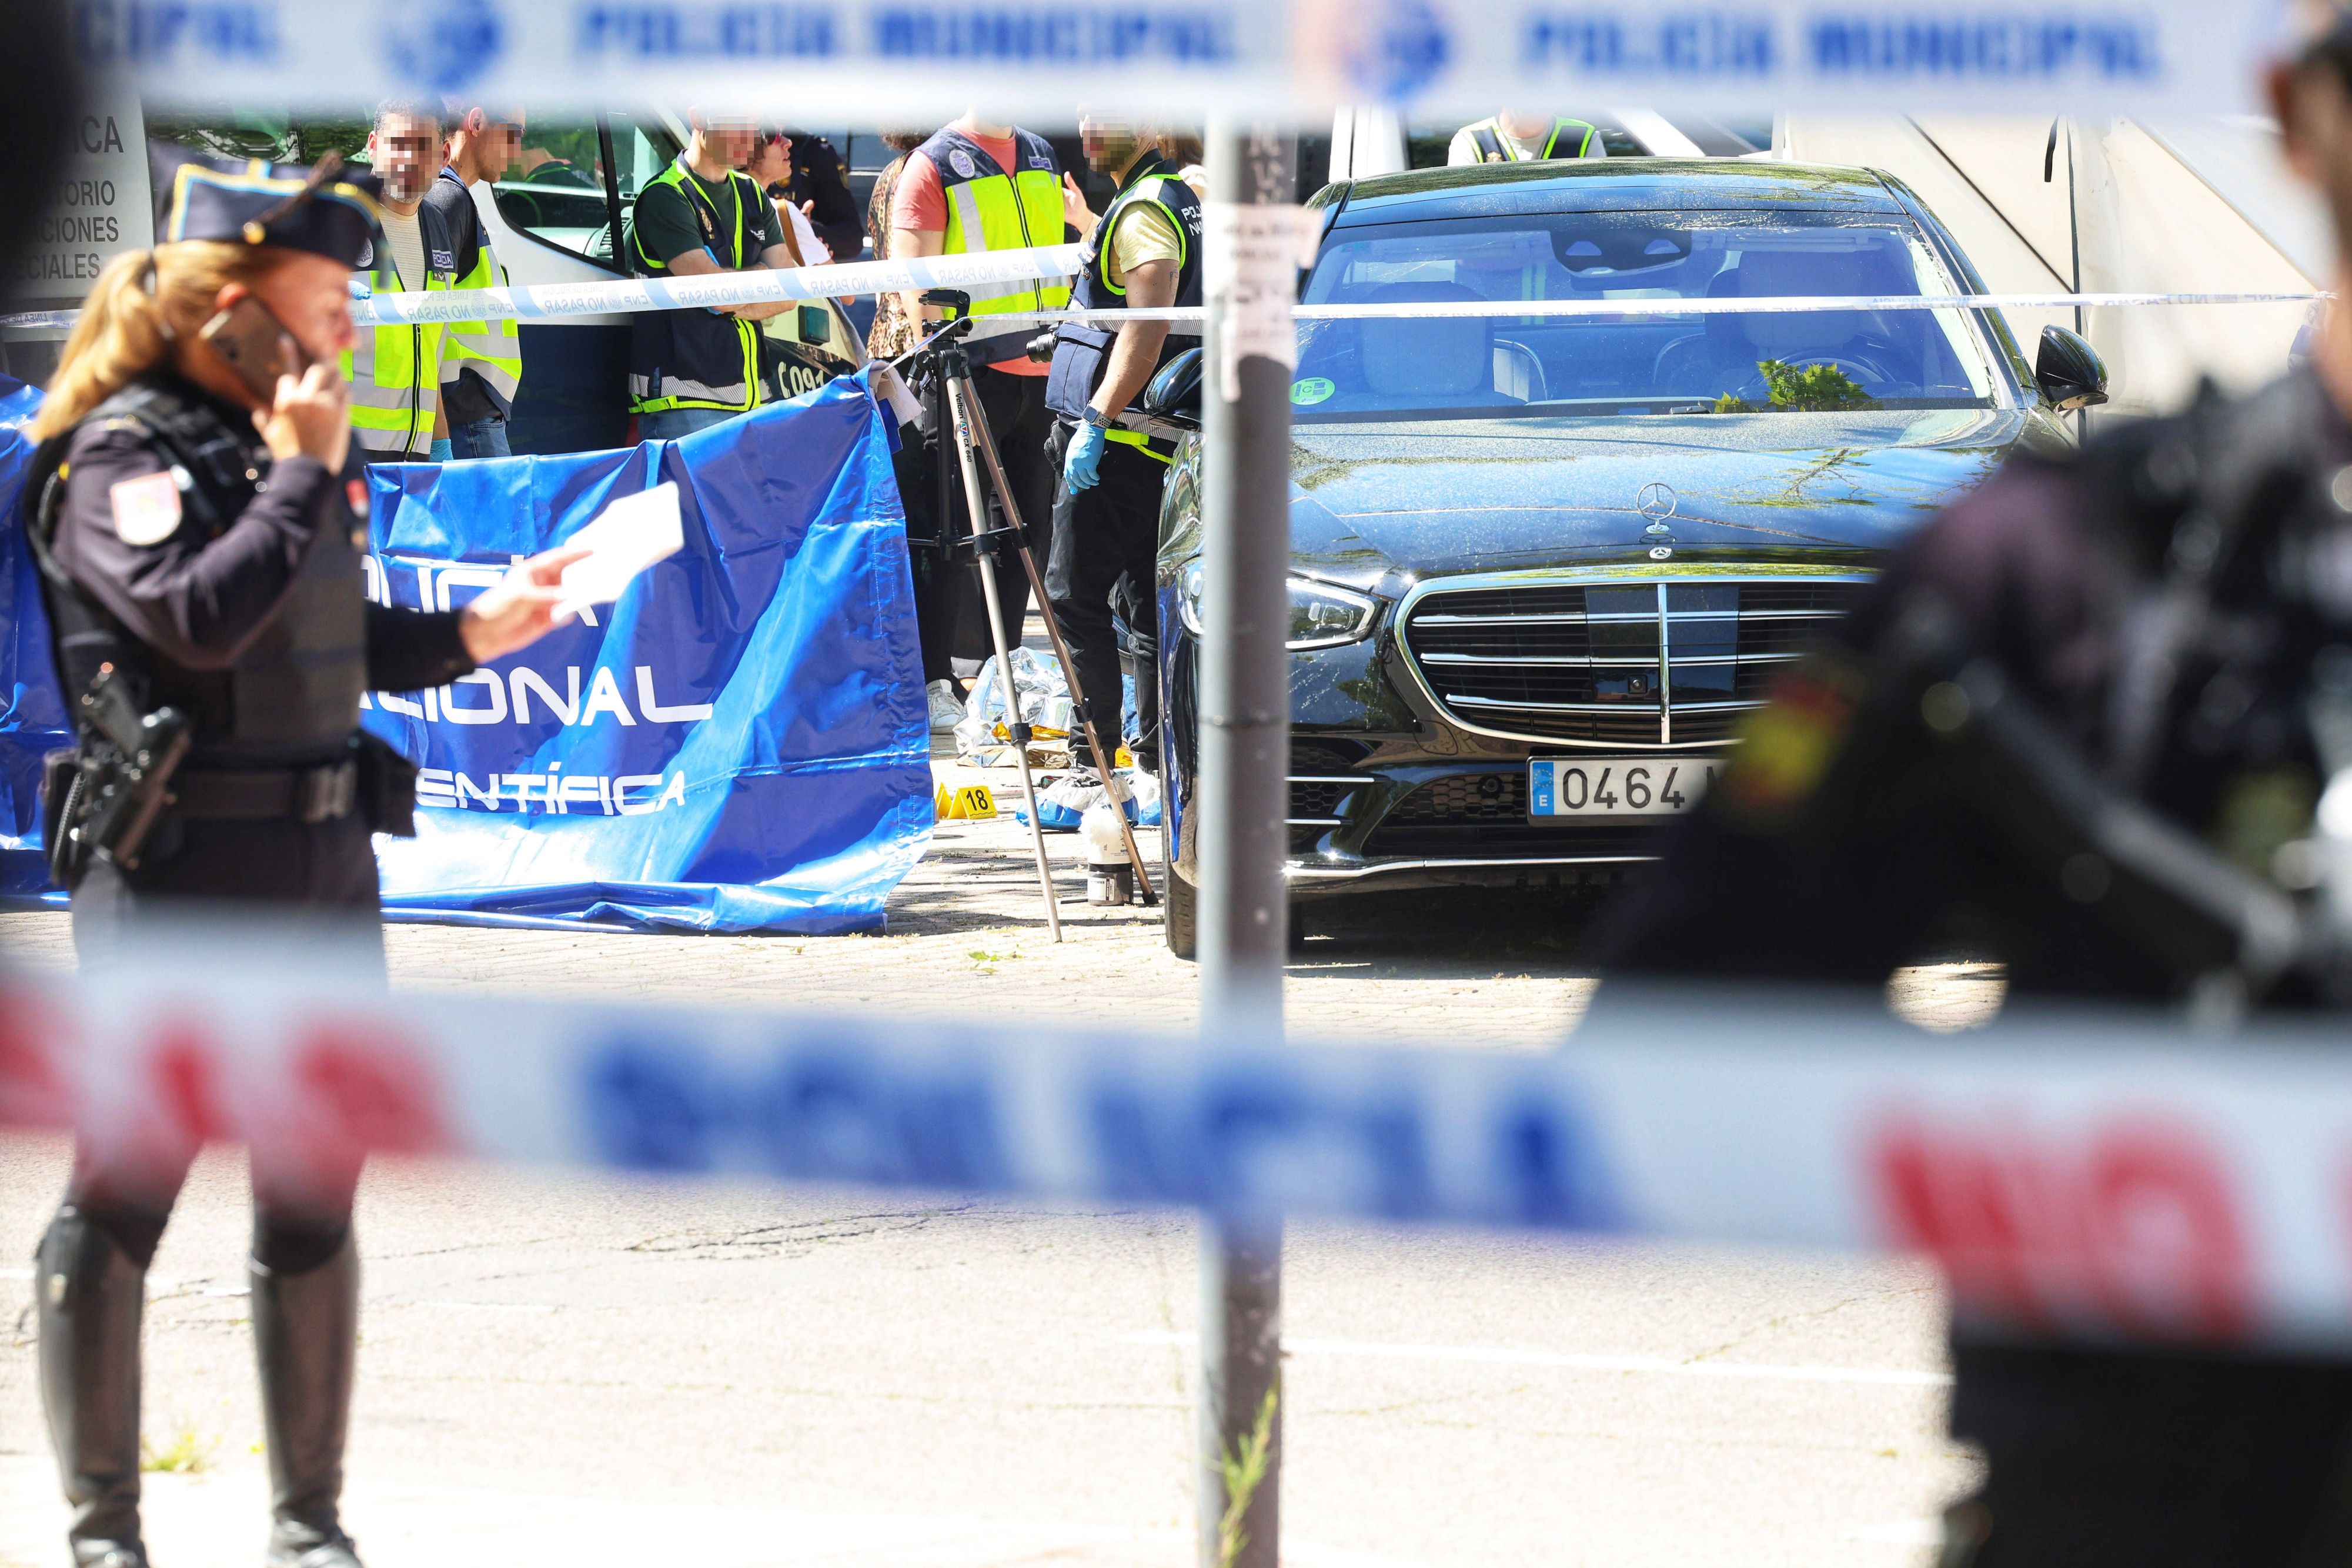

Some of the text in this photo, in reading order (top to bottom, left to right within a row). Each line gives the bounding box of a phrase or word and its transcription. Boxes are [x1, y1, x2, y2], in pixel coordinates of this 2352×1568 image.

[955, 393, 964, 419] Velbon
[415, 761, 685, 817] ENTÍFICA
[966, 789, 988, 811] 18
[1539, 794, 1548, 807] E
[1562, 767, 1685, 810] 0464
